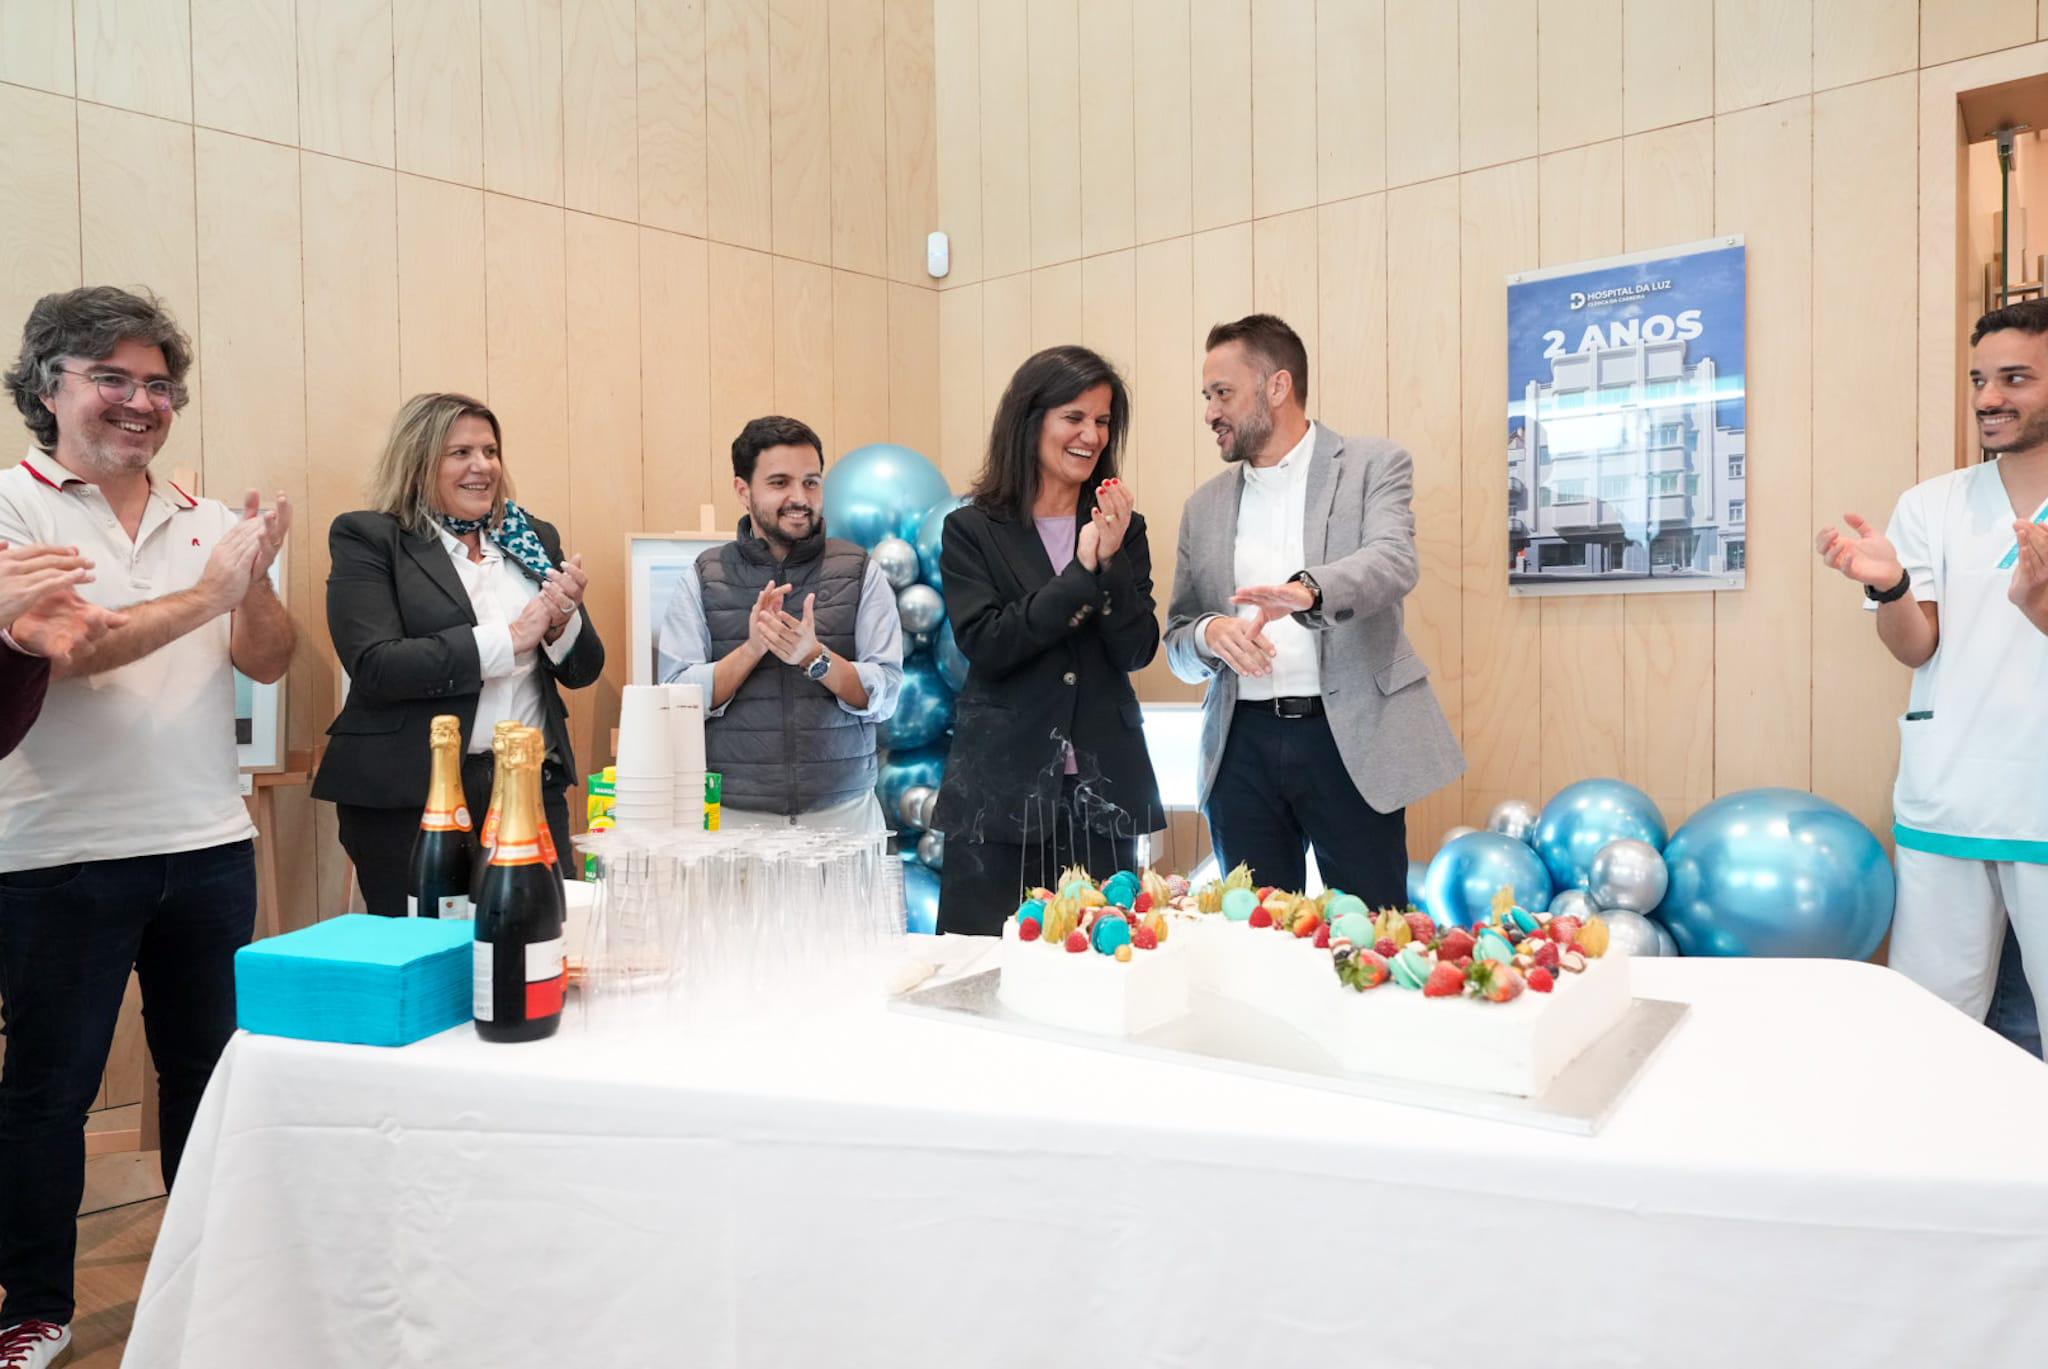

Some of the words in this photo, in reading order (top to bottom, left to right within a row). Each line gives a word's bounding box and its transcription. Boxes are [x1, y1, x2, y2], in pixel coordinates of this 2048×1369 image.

[1587, 287, 1634, 301] HOSPITAL
[1635, 284, 1650, 293] DA
[1651, 280, 1672, 290] LUZ
[1542, 330, 1566, 359] 2
[1577, 310, 1703, 355] ANOS
